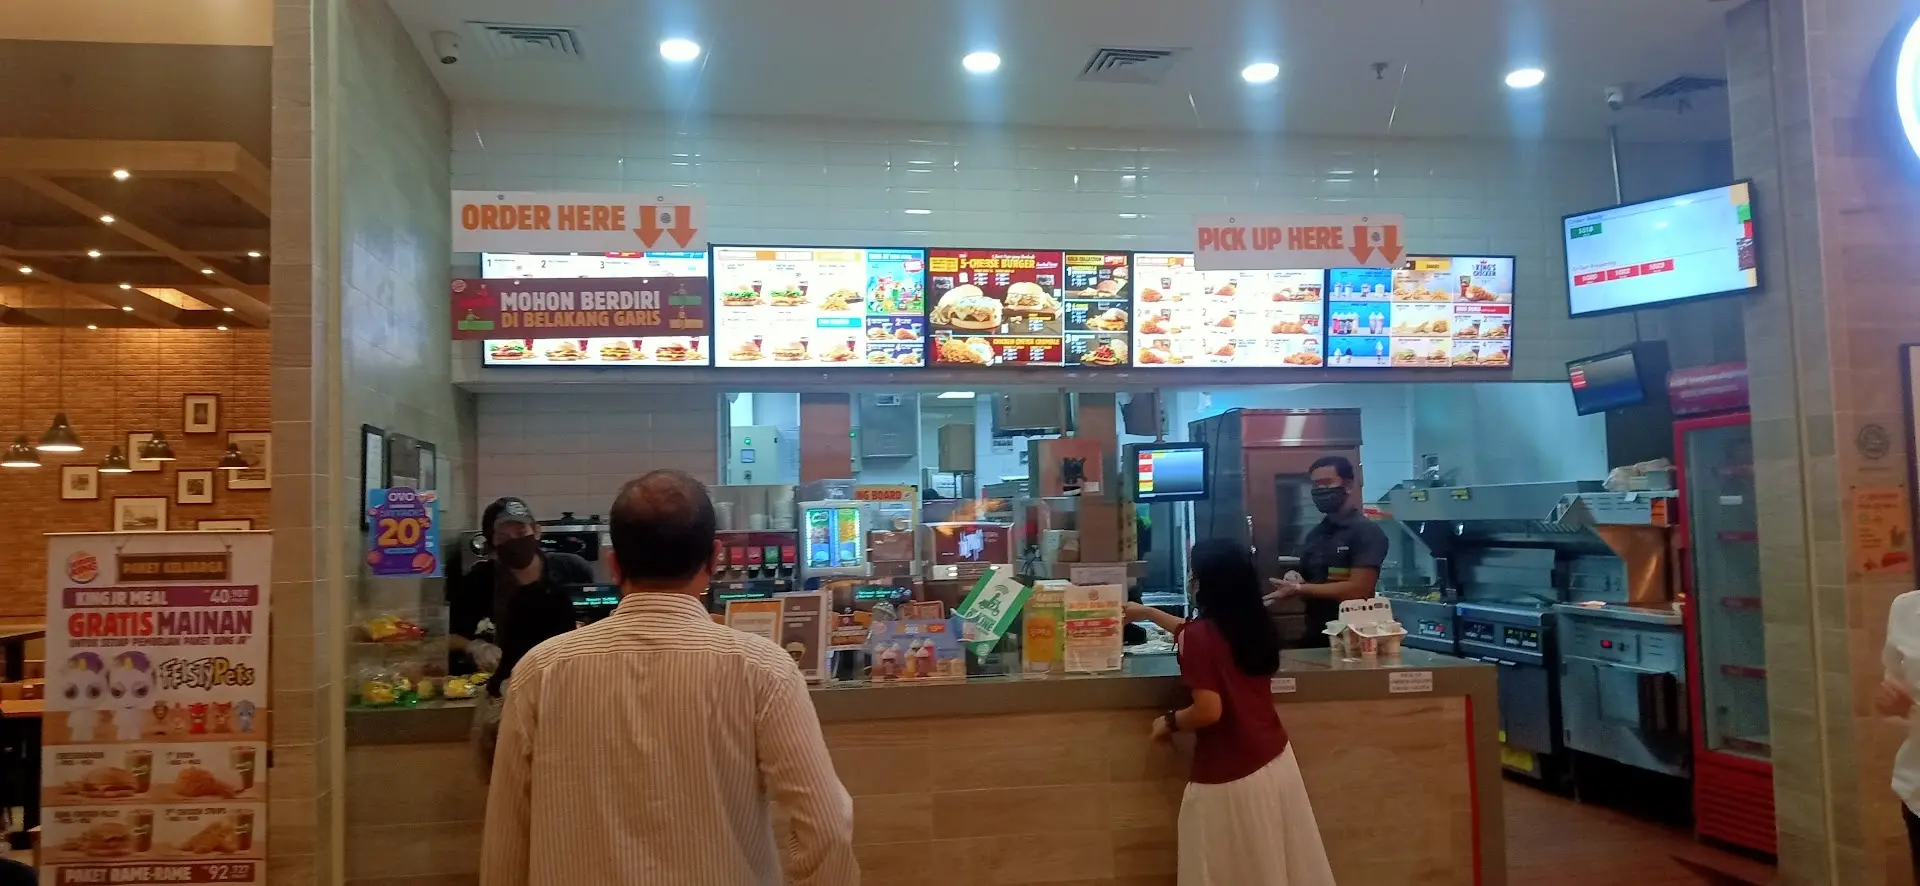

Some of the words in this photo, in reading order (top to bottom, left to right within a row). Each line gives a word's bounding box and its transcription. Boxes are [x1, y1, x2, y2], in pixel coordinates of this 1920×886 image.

[462, 204, 550, 231] ORDER
[558, 205, 626, 231] HERE
[1198, 227, 1247, 251] PICK
[1252, 227, 1282, 250] UP
[1288, 226, 1343, 250] HERE
[541, 260, 546, 269] 2
[600, 261, 605, 269] 3
[1001, 259, 1035, 269] BURGER
[501, 291, 575, 311] MOHON
[580, 290, 660, 311] BERDIRI
[502, 311, 518, 328] DI
[524, 311, 609, 328] BELAKANG
[613, 310, 661, 327] GARIS
[872, 490, 902, 500] BOARD
[378, 518, 420, 546] 20
[75, 592, 110, 606] KING
[130, 591, 168, 605] MEAL
[209, 589, 229, 603] 40
[68, 612, 153, 637] GRATIS
[157, 610, 252, 636] MAINAN
[65, 868, 107, 883] PAKET
[110, 866, 192, 882] RAME-RAME
[208, 865, 228, 880] 92
